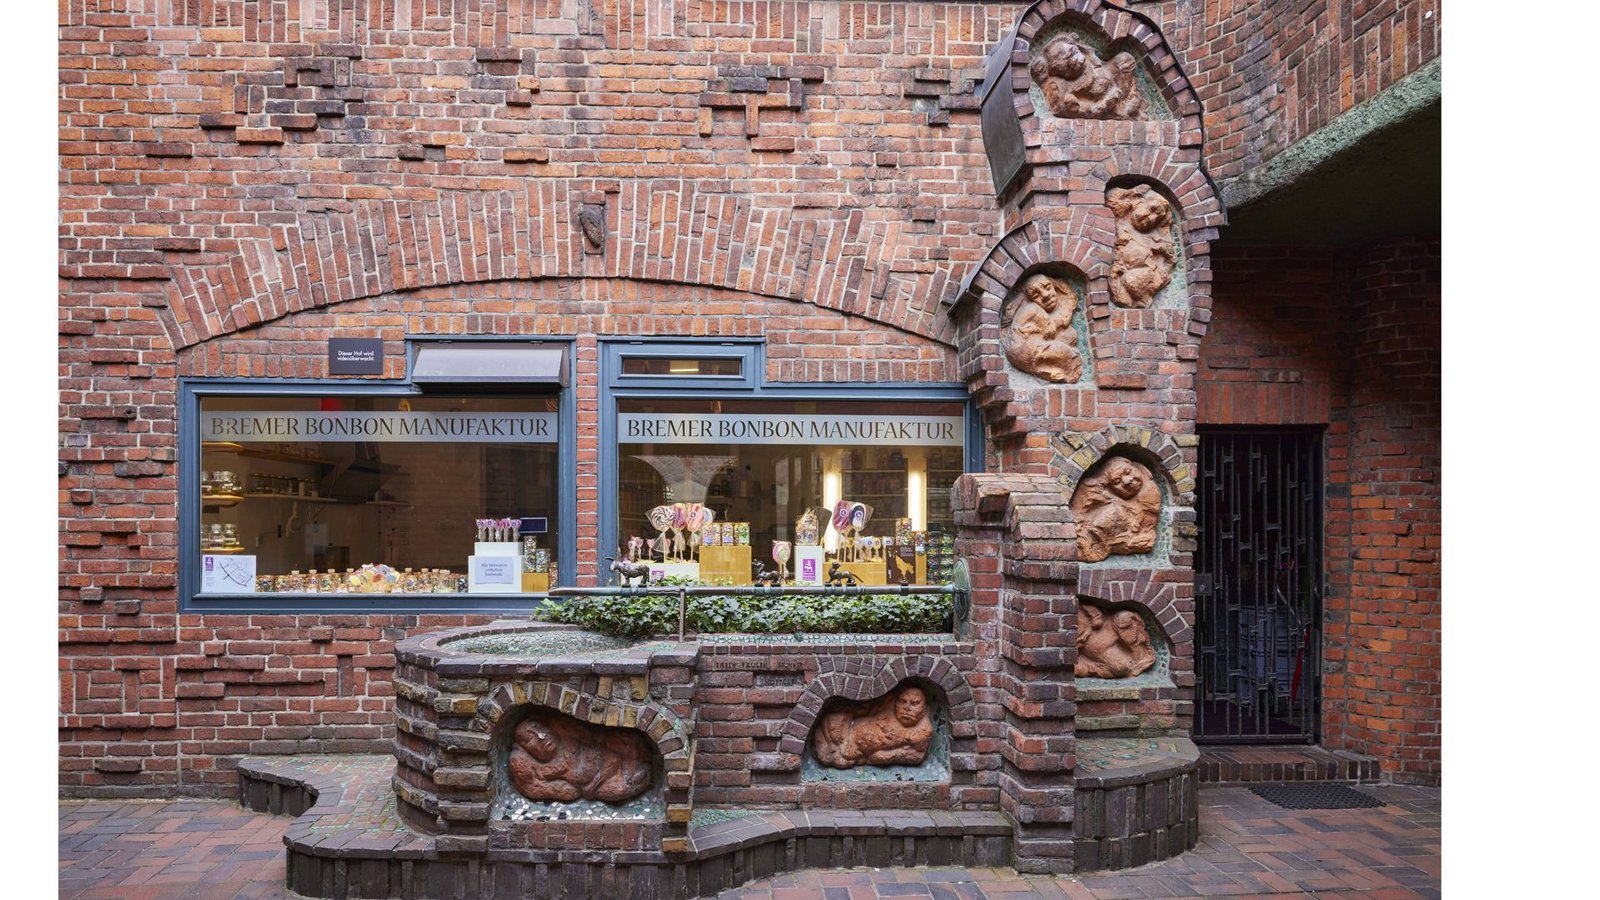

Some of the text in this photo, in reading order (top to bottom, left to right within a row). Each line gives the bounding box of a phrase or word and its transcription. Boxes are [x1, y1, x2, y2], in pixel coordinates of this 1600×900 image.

[211, 417, 549, 436] BREMER BONBON MANUFAKTUR
[627, 419, 955, 439] BREMER BONBON MANUFAKTUR
